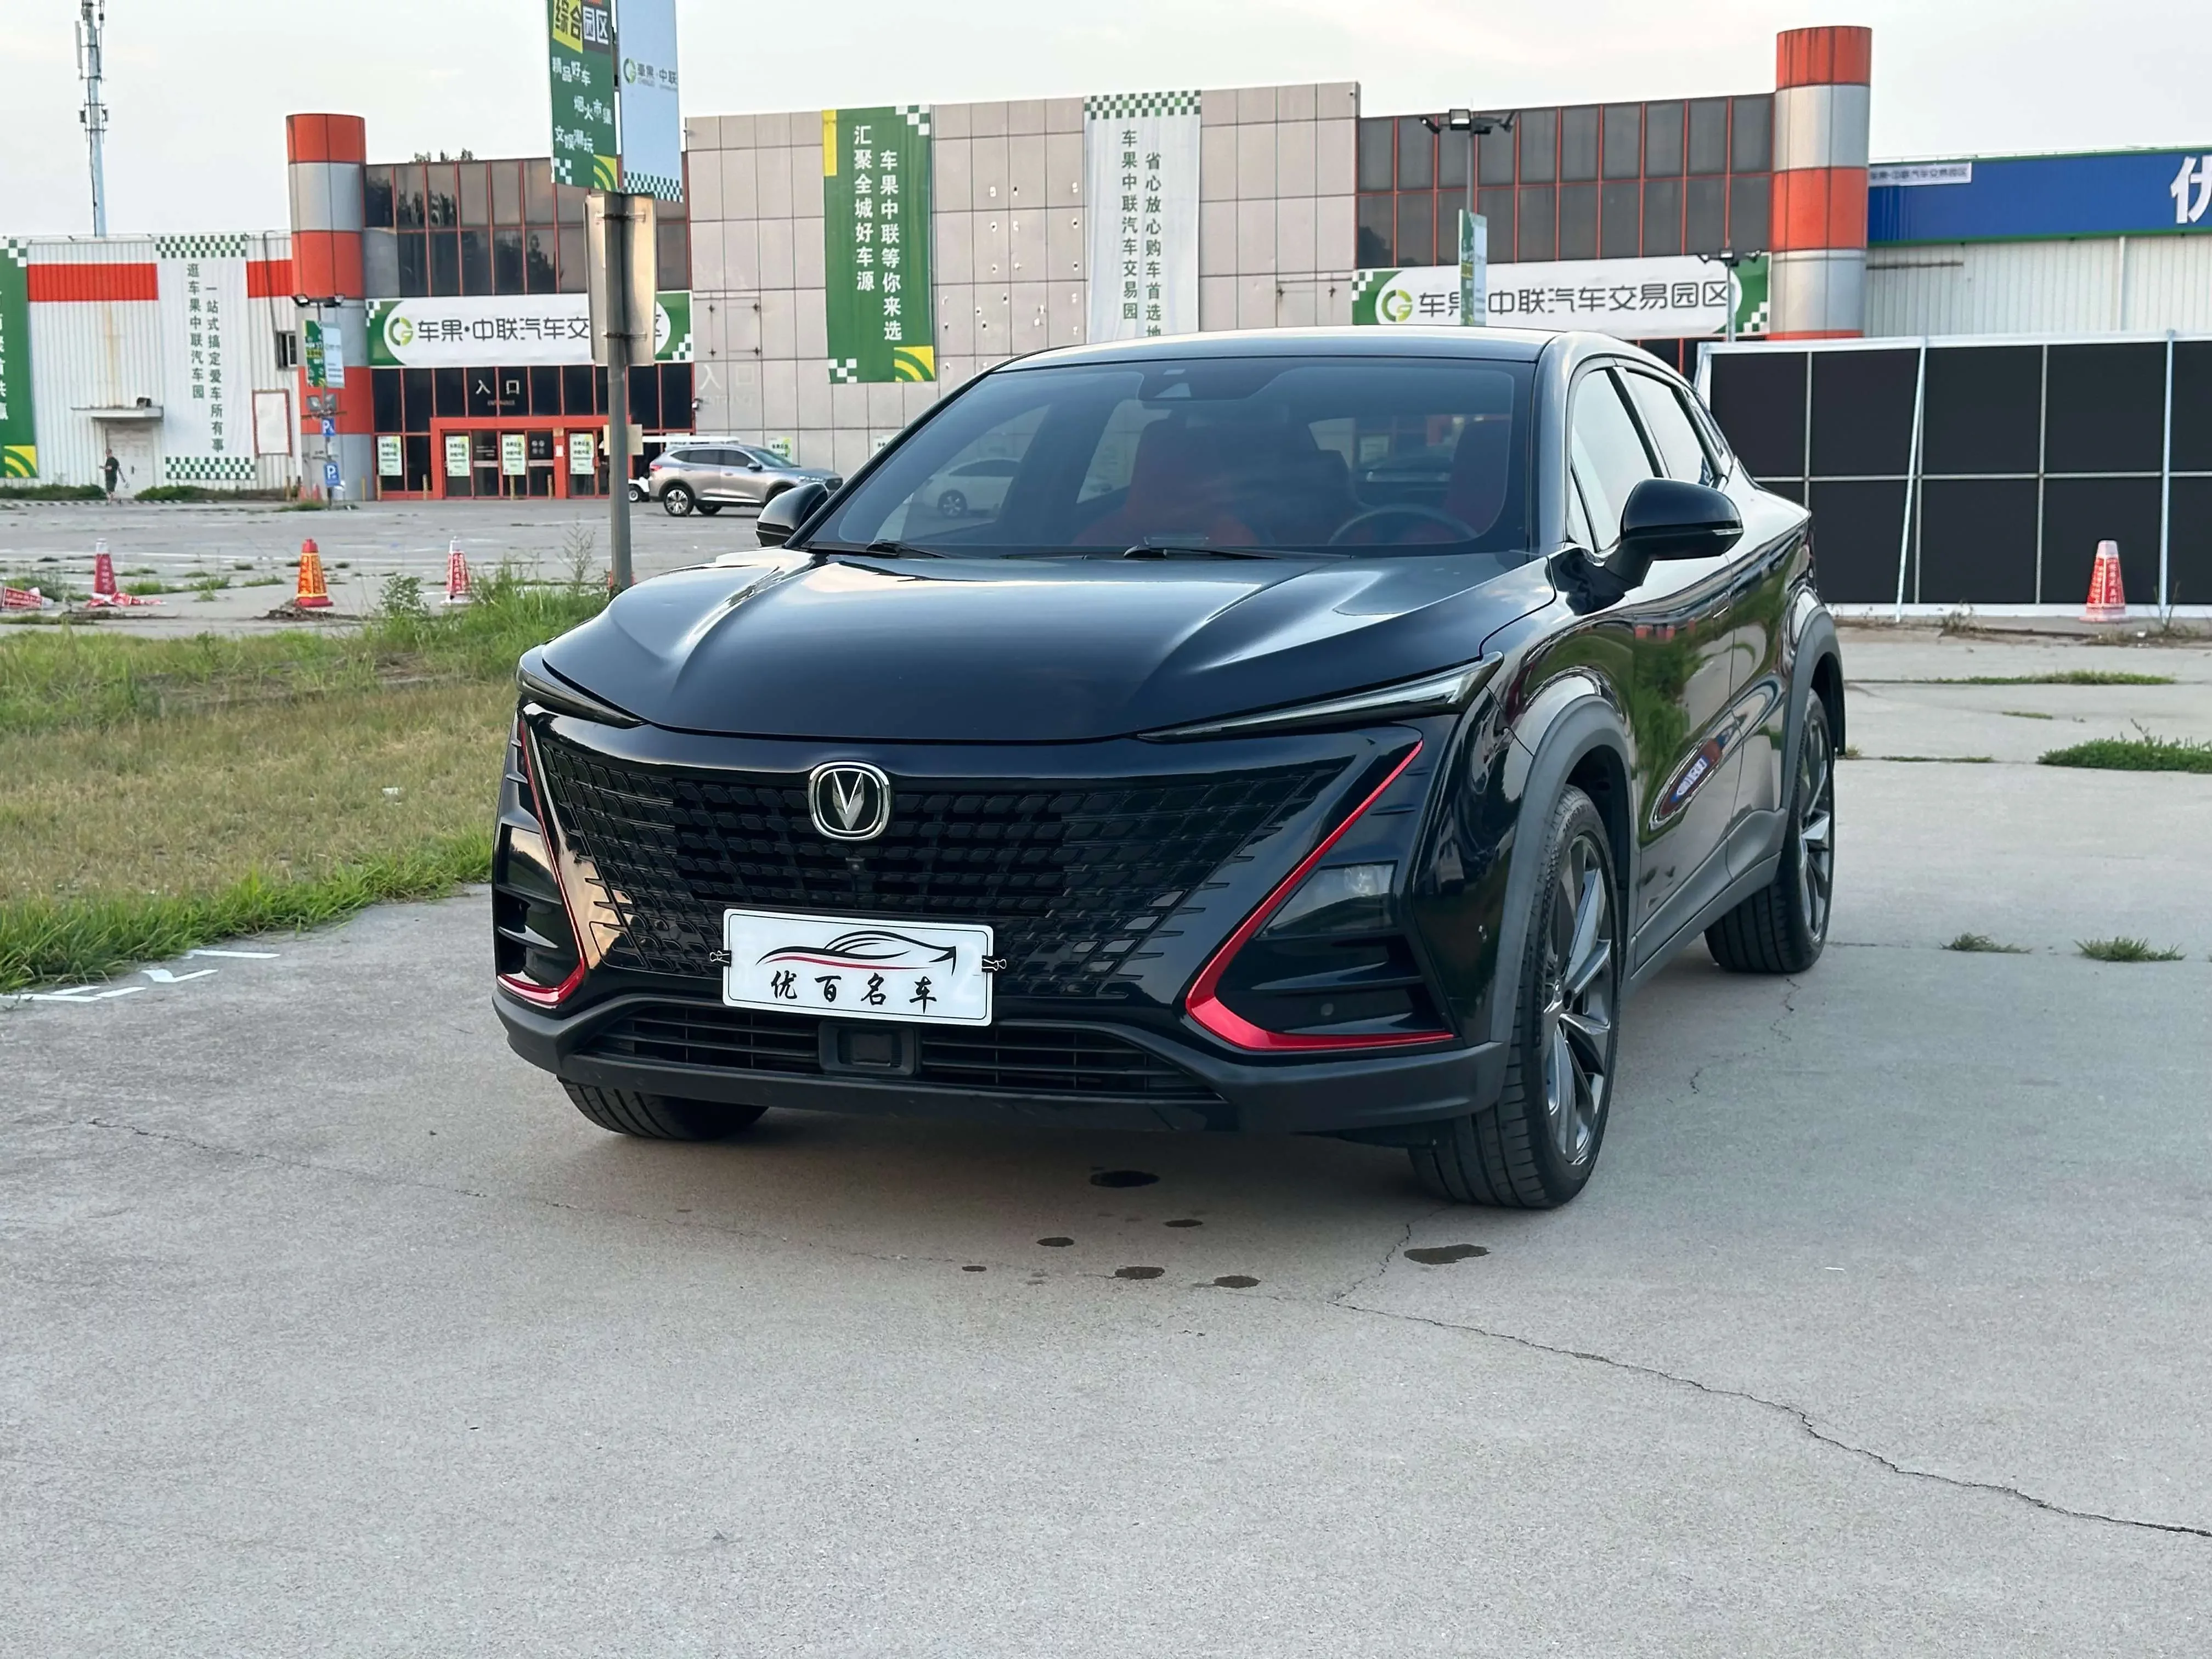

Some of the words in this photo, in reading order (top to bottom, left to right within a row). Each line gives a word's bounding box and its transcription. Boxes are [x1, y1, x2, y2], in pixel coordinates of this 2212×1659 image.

[551, 56, 591, 86] 精品好车
[573, 95, 613, 126] 烟火市集
[854, 125, 875, 291] 汇聚全城好车源
[880, 149, 902, 341] 车果中联等你来选
[1121, 129, 1138, 319] 车果中联汽车交易园
[187, 263, 205, 399] 逛车果中联汽车园
[205, 286, 225, 453] 一站式搞定爱车所有事
[475, 379, 520, 394] 入口
[326, 465, 336, 480] P
[770, 969, 938, 1014] 优百名车
